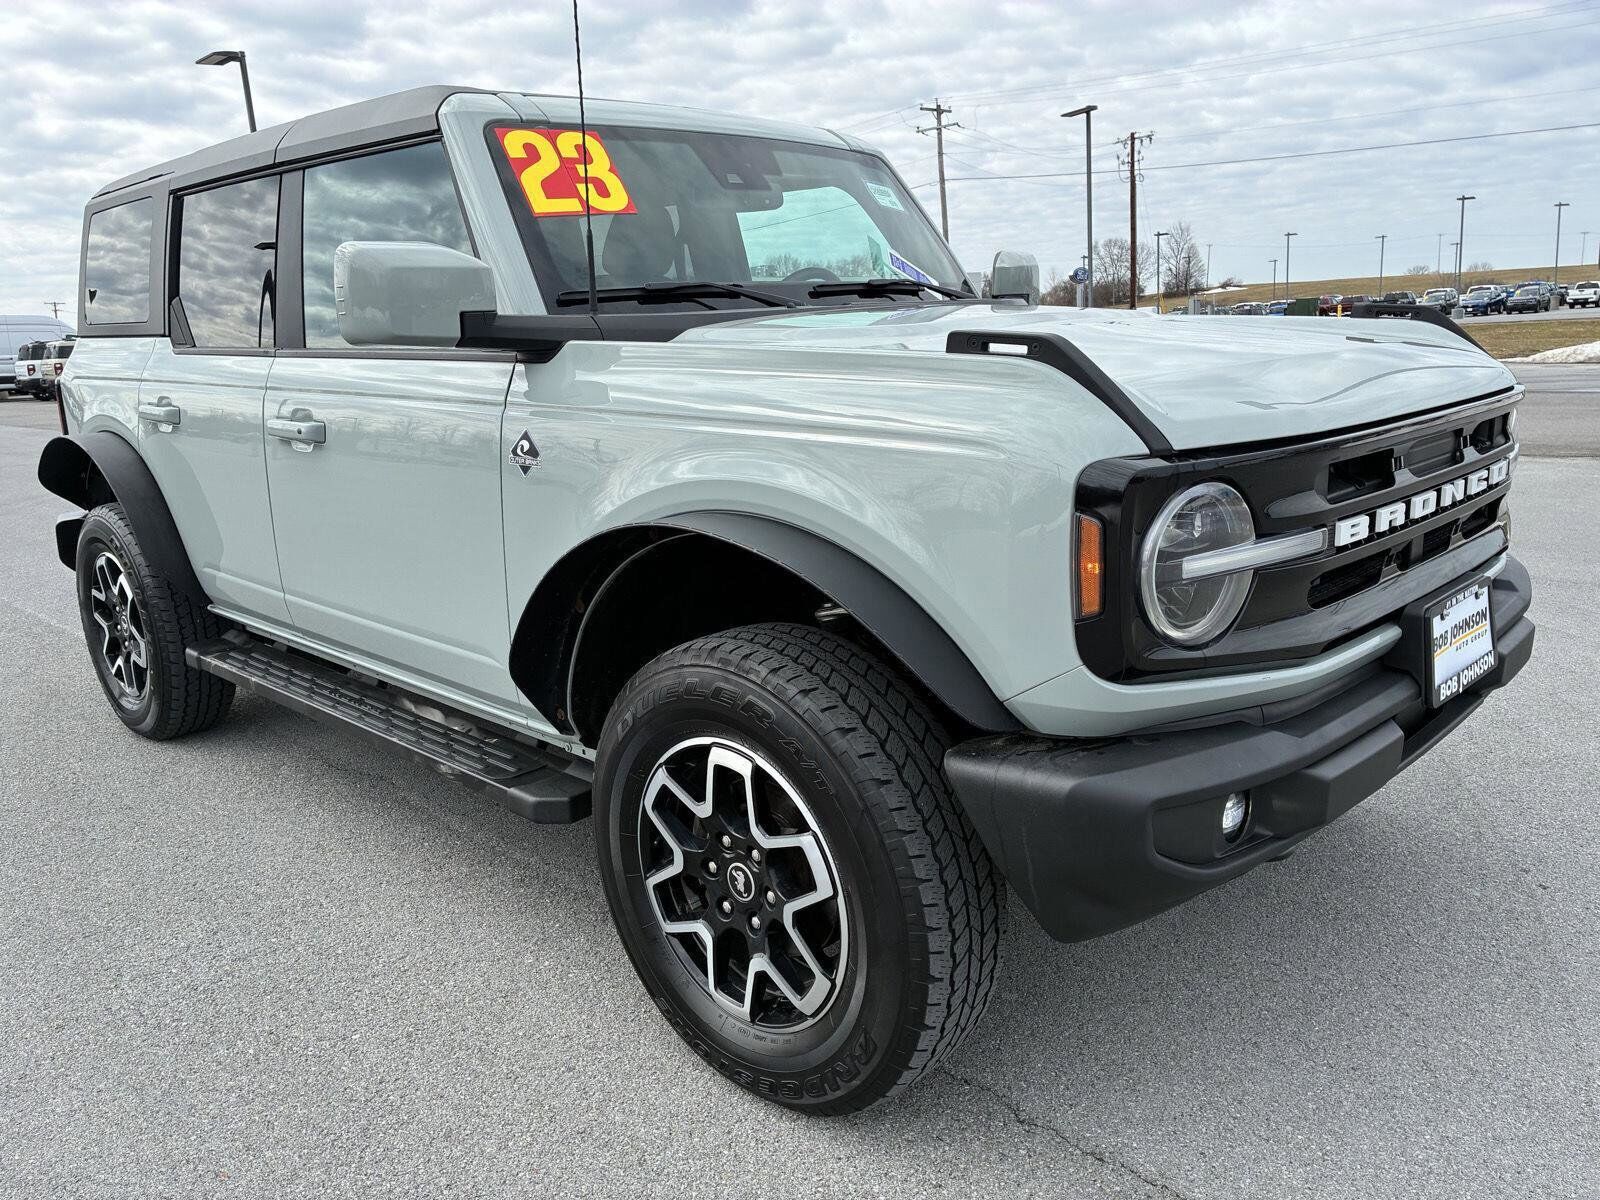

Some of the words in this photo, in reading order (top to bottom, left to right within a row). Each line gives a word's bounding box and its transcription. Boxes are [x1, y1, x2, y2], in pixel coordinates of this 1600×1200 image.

[503, 129, 629, 214] 23
[1334, 457, 1509, 548] BRONCO
[1433, 629, 1449, 653] BOB
[1449, 606, 1488, 647] JOHNSON
[1455, 640, 1469, 652] AUTO
[1471, 629, 1488, 643] GROUP
[1440, 676, 1458, 702] BOB
[1458, 650, 1495, 694] JOHNSON
[616, 678, 776, 743] DUELER
[778, 737, 834, 796] A/T
